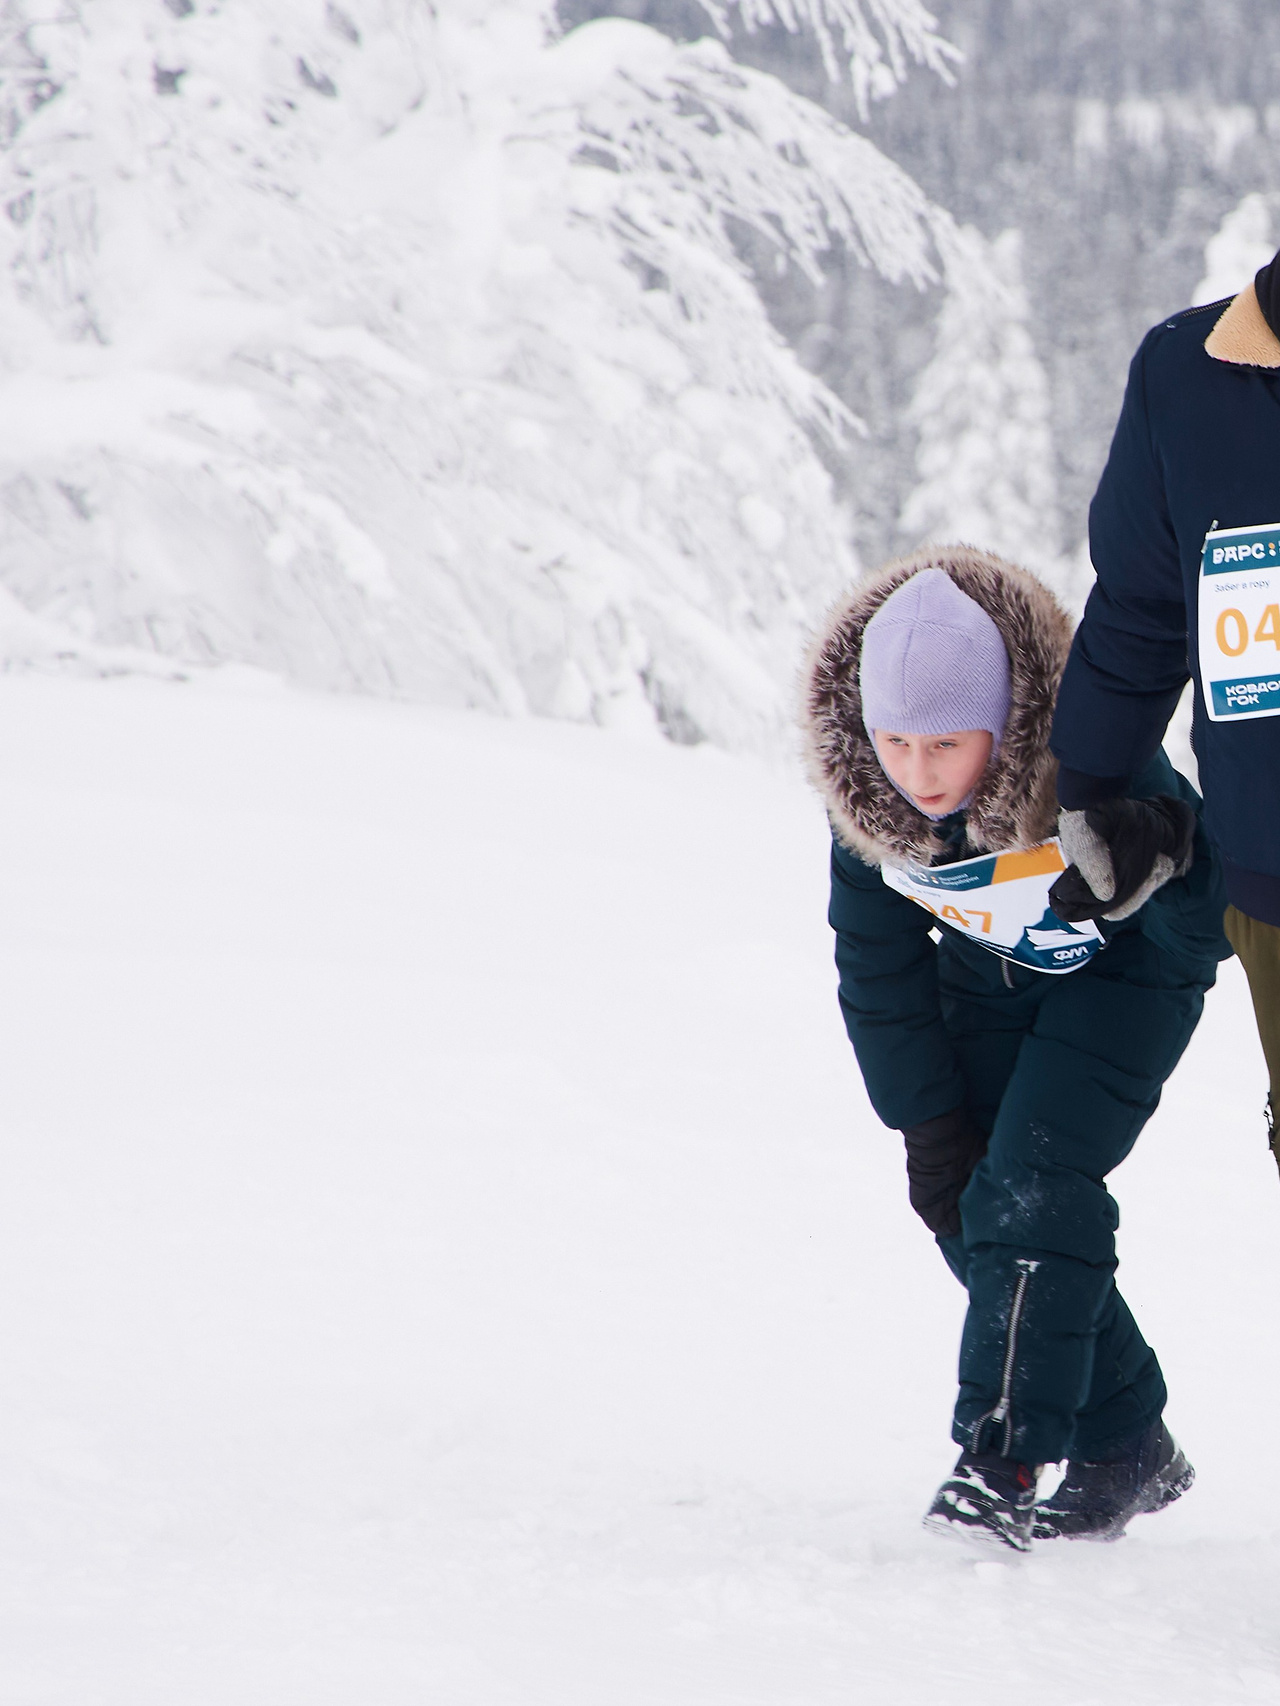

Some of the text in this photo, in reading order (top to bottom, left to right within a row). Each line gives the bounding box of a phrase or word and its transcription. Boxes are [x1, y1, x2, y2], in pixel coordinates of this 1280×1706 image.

[1213, 543, 1266, 564] ВАРС
[1214, 583, 1240, 592] Забег
[1250, 580, 1271, 590] гору
[1227, 693, 1260, 707] ГОК
